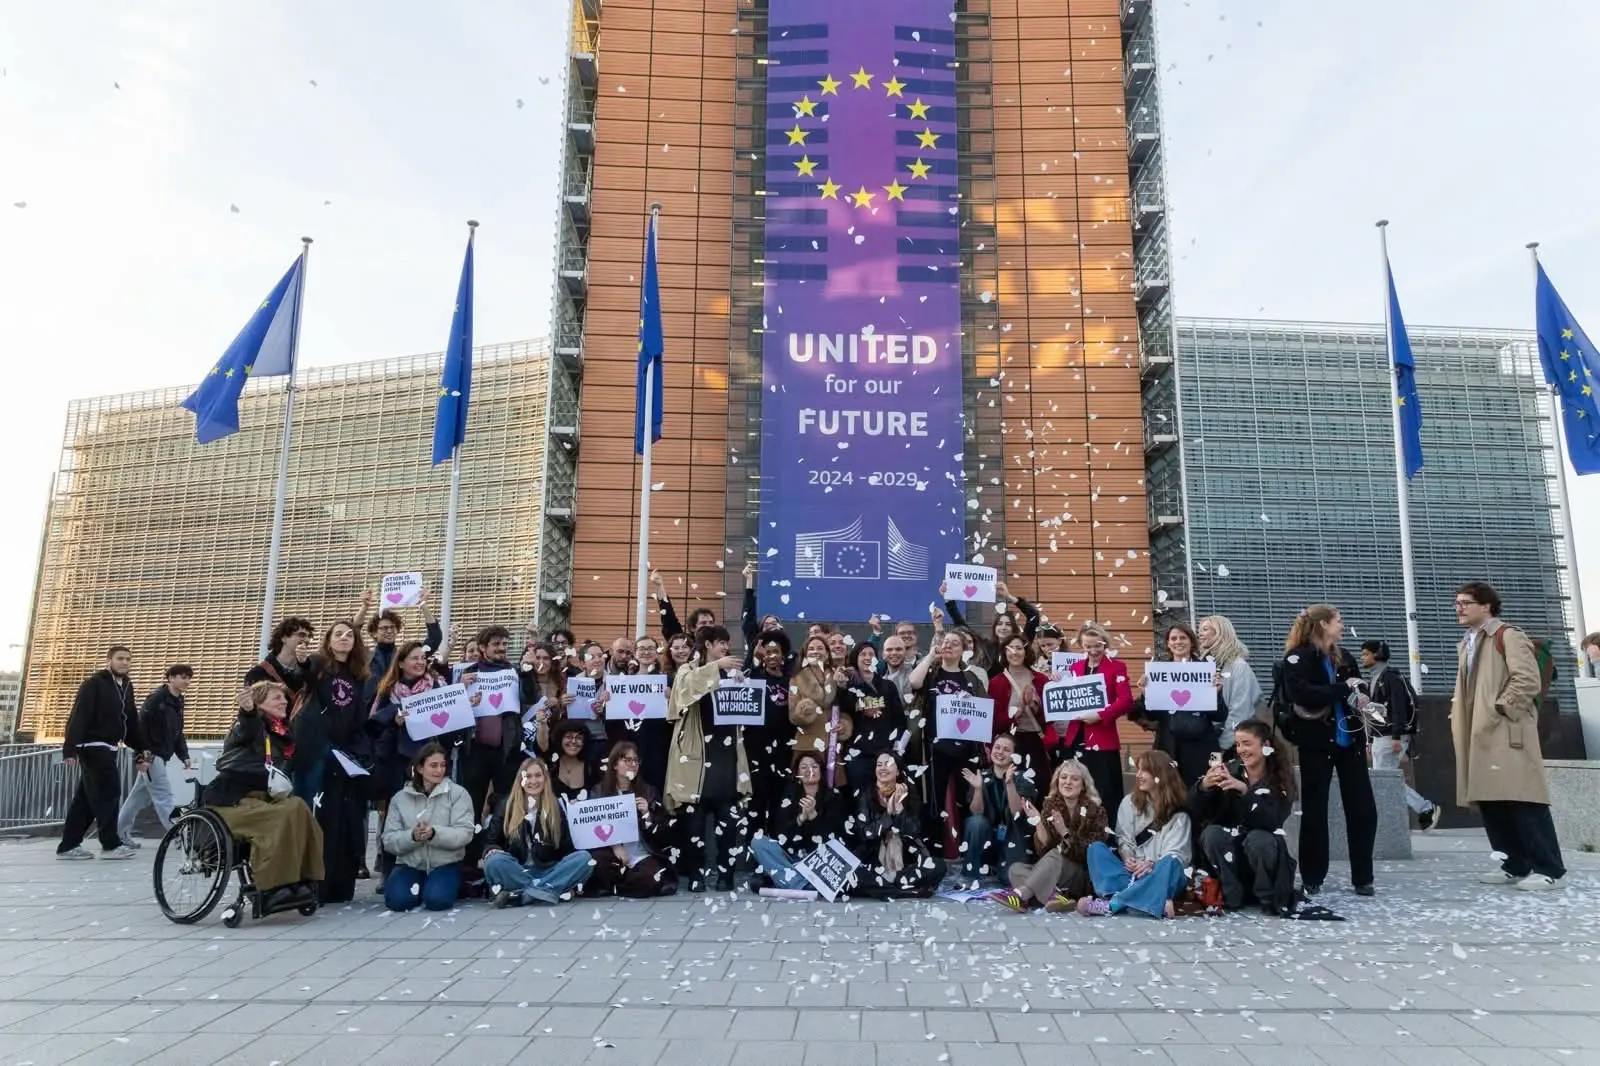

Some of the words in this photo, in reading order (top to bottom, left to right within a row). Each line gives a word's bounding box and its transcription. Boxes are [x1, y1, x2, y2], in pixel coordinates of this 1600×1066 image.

[789, 333, 937, 364] UNITED
[825, 373, 857, 393] for
[864, 378, 902, 394] our
[799, 409, 928, 436] FUTURE
[808, 470, 854, 485] 2024
[871, 471, 917, 487] 2029
[949, 571, 962, 580] WE
[964, 572, 993, 581] WON!!!
[1149, 671, 1168, 683] WE
[1170, 671, 1211, 683] WON!!!
[611, 683, 626, 694] WE
[628, 683, 664, 694] WON!!
[1049, 690, 1063, 700] MY
[1065, 686, 1093, 699] VOICE
[717, 690, 730, 701] MY
[719, 701, 730, 712] MY
[730, 701, 759, 713] CHOICE
[950, 700, 961, 708] WE
[961, 701, 976, 709] WILL
[1050, 700, 1065, 710] MY
[1066, 695, 1102, 710] CHOICE
[579, 803, 615, 815] ABORTION
[573, 817, 578, 825] A
[607, 811, 629, 820] RIGHT
